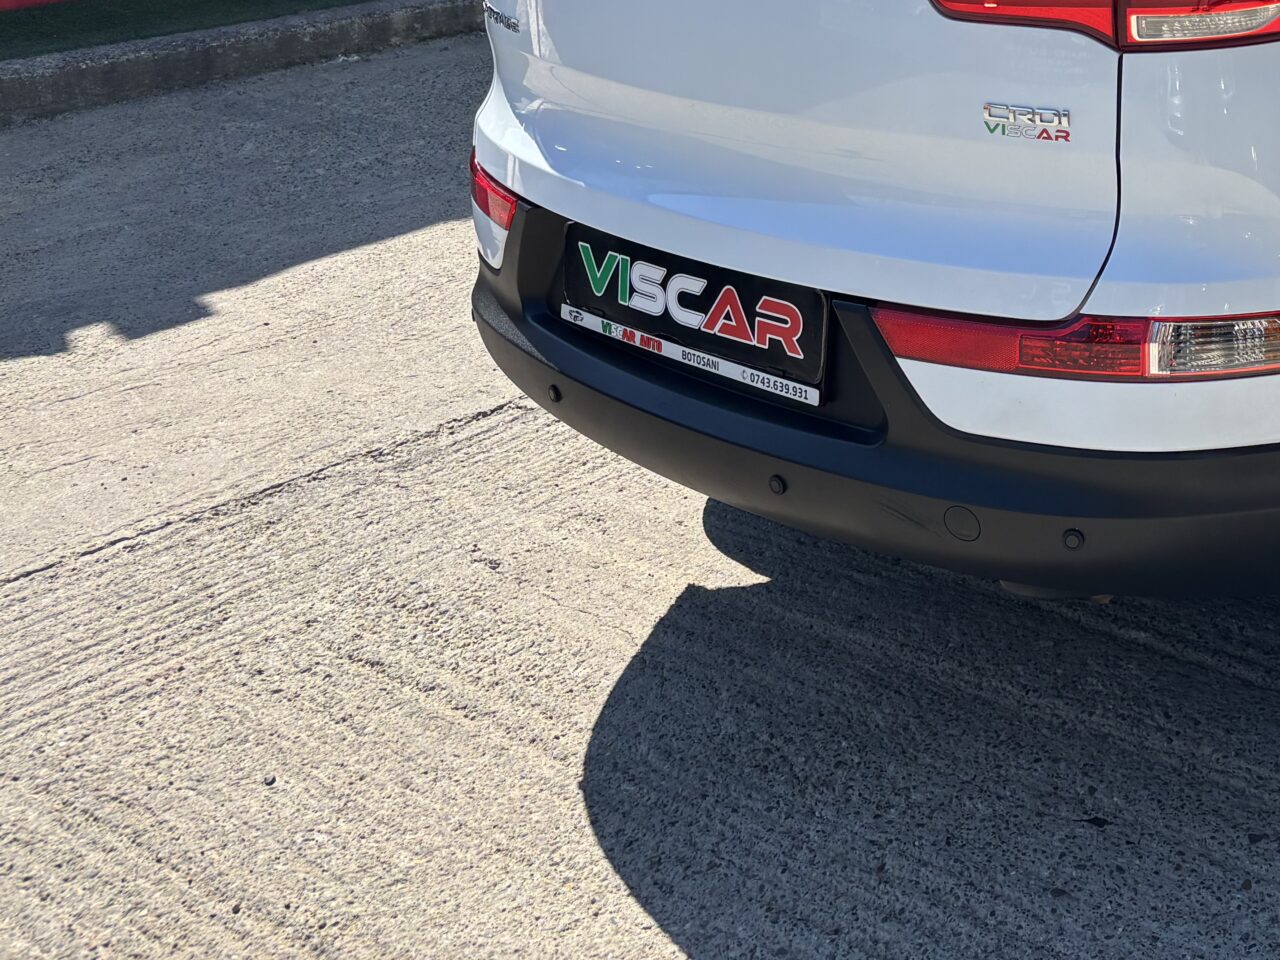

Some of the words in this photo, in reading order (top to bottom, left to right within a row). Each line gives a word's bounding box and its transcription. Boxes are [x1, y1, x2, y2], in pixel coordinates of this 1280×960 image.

[983, 120, 1071, 143] VISCAR
[578, 241, 804, 359] VISCAR
[601, 319, 637, 345] VISCAR
[639, 334, 663, 354] AUTO
[681, 349, 720, 372] BOTOSANI
[749, 372, 809, 400] 0743.639.931
